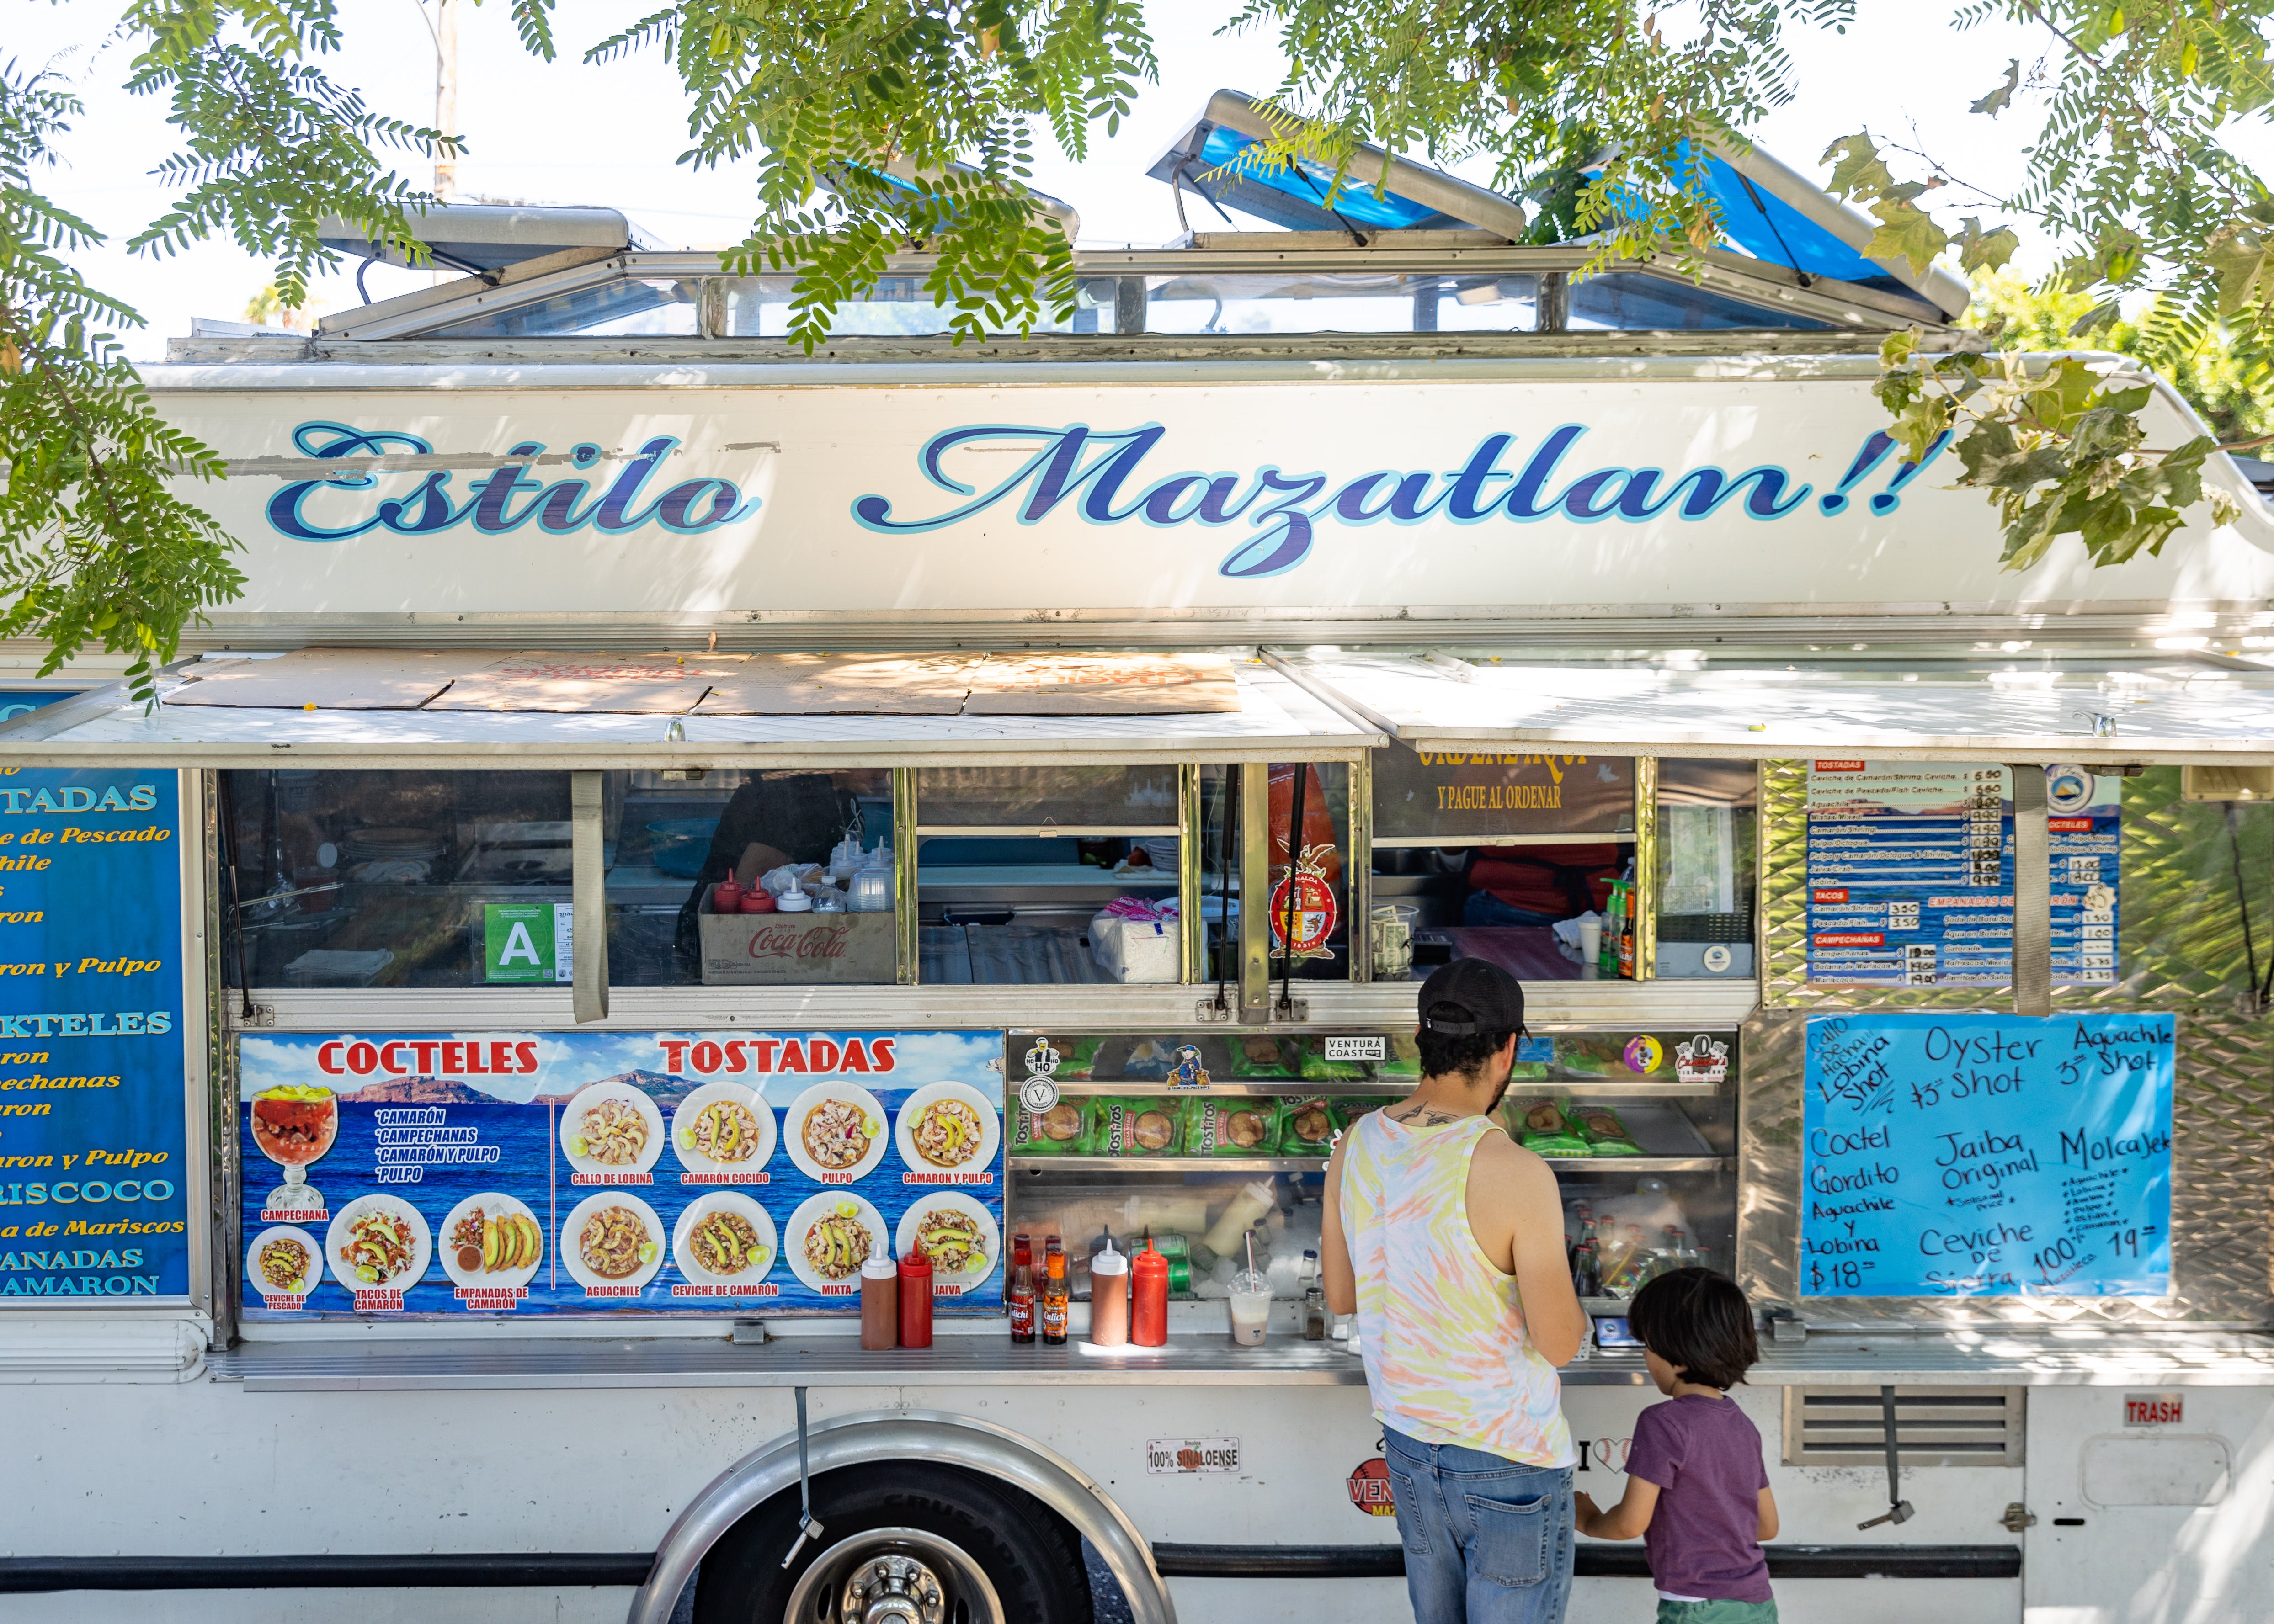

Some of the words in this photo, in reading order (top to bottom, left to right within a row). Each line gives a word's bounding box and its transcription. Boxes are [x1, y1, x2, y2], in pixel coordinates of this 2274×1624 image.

[265, 420, 762, 542] Estilo
[0, 784, 158, 814] TADAS
[1438, 786, 1446, 809] Y
[1448, 786, 1486, 810] PAGUE
[1488, 786, 1504, 809] AL
[1506, 786, 1562, 809] ORDENAR
[2048, 821, 2089, 829] OCTELES
[20, 829, 54, 844] de
[60, 826, 171, 844] Pescado
[499, 922, 541, 965] A
[749, 926, 852, 959] Coca-Cola
[1815, 935, 1880, 944] CAMPECHANAS
[55, 962, 70, 978] y
[77, 957, 161, 977] Pulpo
[1925, 1026, 2042, 1068] Oyster
[317, 1041, 539, 1074] COCTELES
[659, 1040, 895, 1073] TOSTADAS
[1035, 1063, 1050, 1072] HO
[379, 1108, 444, 1124] CAMARÓN
[379, 1129, 476, 1143] CAMPECHANAS
[1811, 1125, 1890, 1157] Coctel
[379, 1146, 446, 1162] CAMARÓN
[447, 1149, 456, 1162] Y
[456, 1148, 498, 1162] PULPO
[1934, 1130, 2024, 1166] Jaiba
[63, 1153, 79, 1170] y
[85, 1149, 169, 1168] Pulpo
[1942, 1148, 2039, 1189] Original
[379, 1167, 422, 1182] PULPO
[572, 1173, 602, 1185] CALLO
[603, 1173, 617, 1185] DE
[618, 1173, 654, 1185] LOBINA
[682, 1171, 722, 1185] CAMARÓN
[724, 1173, 770, 1184] COCIDO
[822, 1173, 853, 1184] PULPO
[949, 1173, 959, 1185] Y
[959, 1173, 992, 1185] PULPO
[1811, 1162, 1899, 1194] Gordito
[262, 1210, 329, 1221] CAMPECHANA
[1812, 1197, 1895, 1223] Aguachile
[25, 1221, 59, 1237] de
[64, 1217, 185, 1237] Mariscos
[1807, 1237, 1880, 1255] Lobina
[1921, 1221, 2034, 1255] Ceviche
[0, 1248, 144, 1272] ANADAS
[0, 1275, 160, 1296] AMARON
[356, 1289, 388, 1300] TACOS
[390, 1289, 402, 1299] DE
[455, 1288, 513, 1299] EMPANADAS
[515, 1288, 528, 1299] DE
[586, 1285, 640, 1297] AGUACHILE
[672, 1284, 714, 1296] CEVICHE
[714, 1284, 729, 1296] DE
[730, 1282, 778, 1296] CAMARÓN
[822, 1284, 853, 1296] MIXTA
[935, 1284, 962, 1296] JAIVA
[264, 1295, 293, 1303] CEVICHE
[295, 1294, 305, 1303] DE
[267, 1301, 303, 1310] PESCADO
[355, 1296, 403, 1310] CAMARÓN
[467, 1295, 516, 1310] CAMARÓN
[1044, 1311, 1066, 1321] Culichi
[2127, 1401, 2183, 1422] TRASH
[1149, 1451, 1174, 1468] 100%
[1177, 1449, 1237, 1467] SINALOENSE
[1578, 1440, 1591, 1471] I
